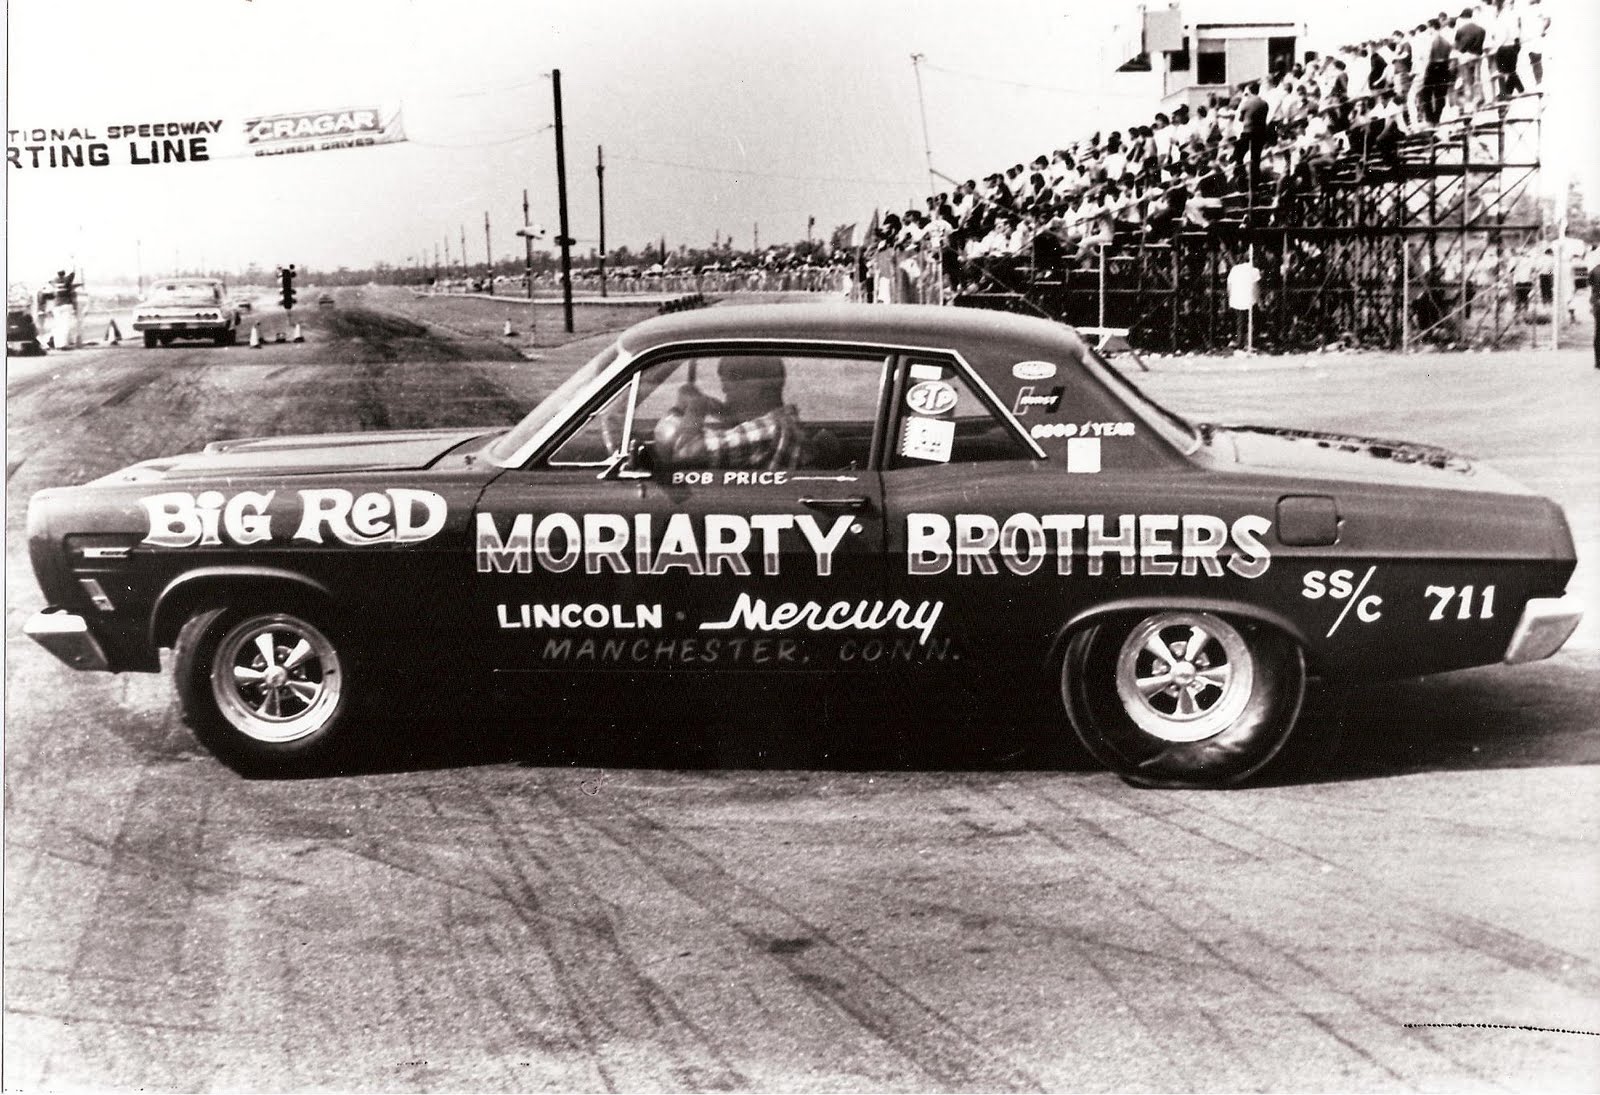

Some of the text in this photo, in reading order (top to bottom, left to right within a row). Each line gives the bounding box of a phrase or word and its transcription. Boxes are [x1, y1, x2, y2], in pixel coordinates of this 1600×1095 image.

[107, 119, 223, 140] SPEEDWAY
[250, 111, 377, 140] CRAGAR
[7, 137, 210, 169] RTING LINE
[911, 384, 954, 410] STP
[672, 471, 788, 485] BOB PRICE
[476, 512, 1273, 579] MORIARTY BROTHERS
[1424, 584, 1496, 621] 711
[497, 592, 944, 645] LINCOLN Mercury
